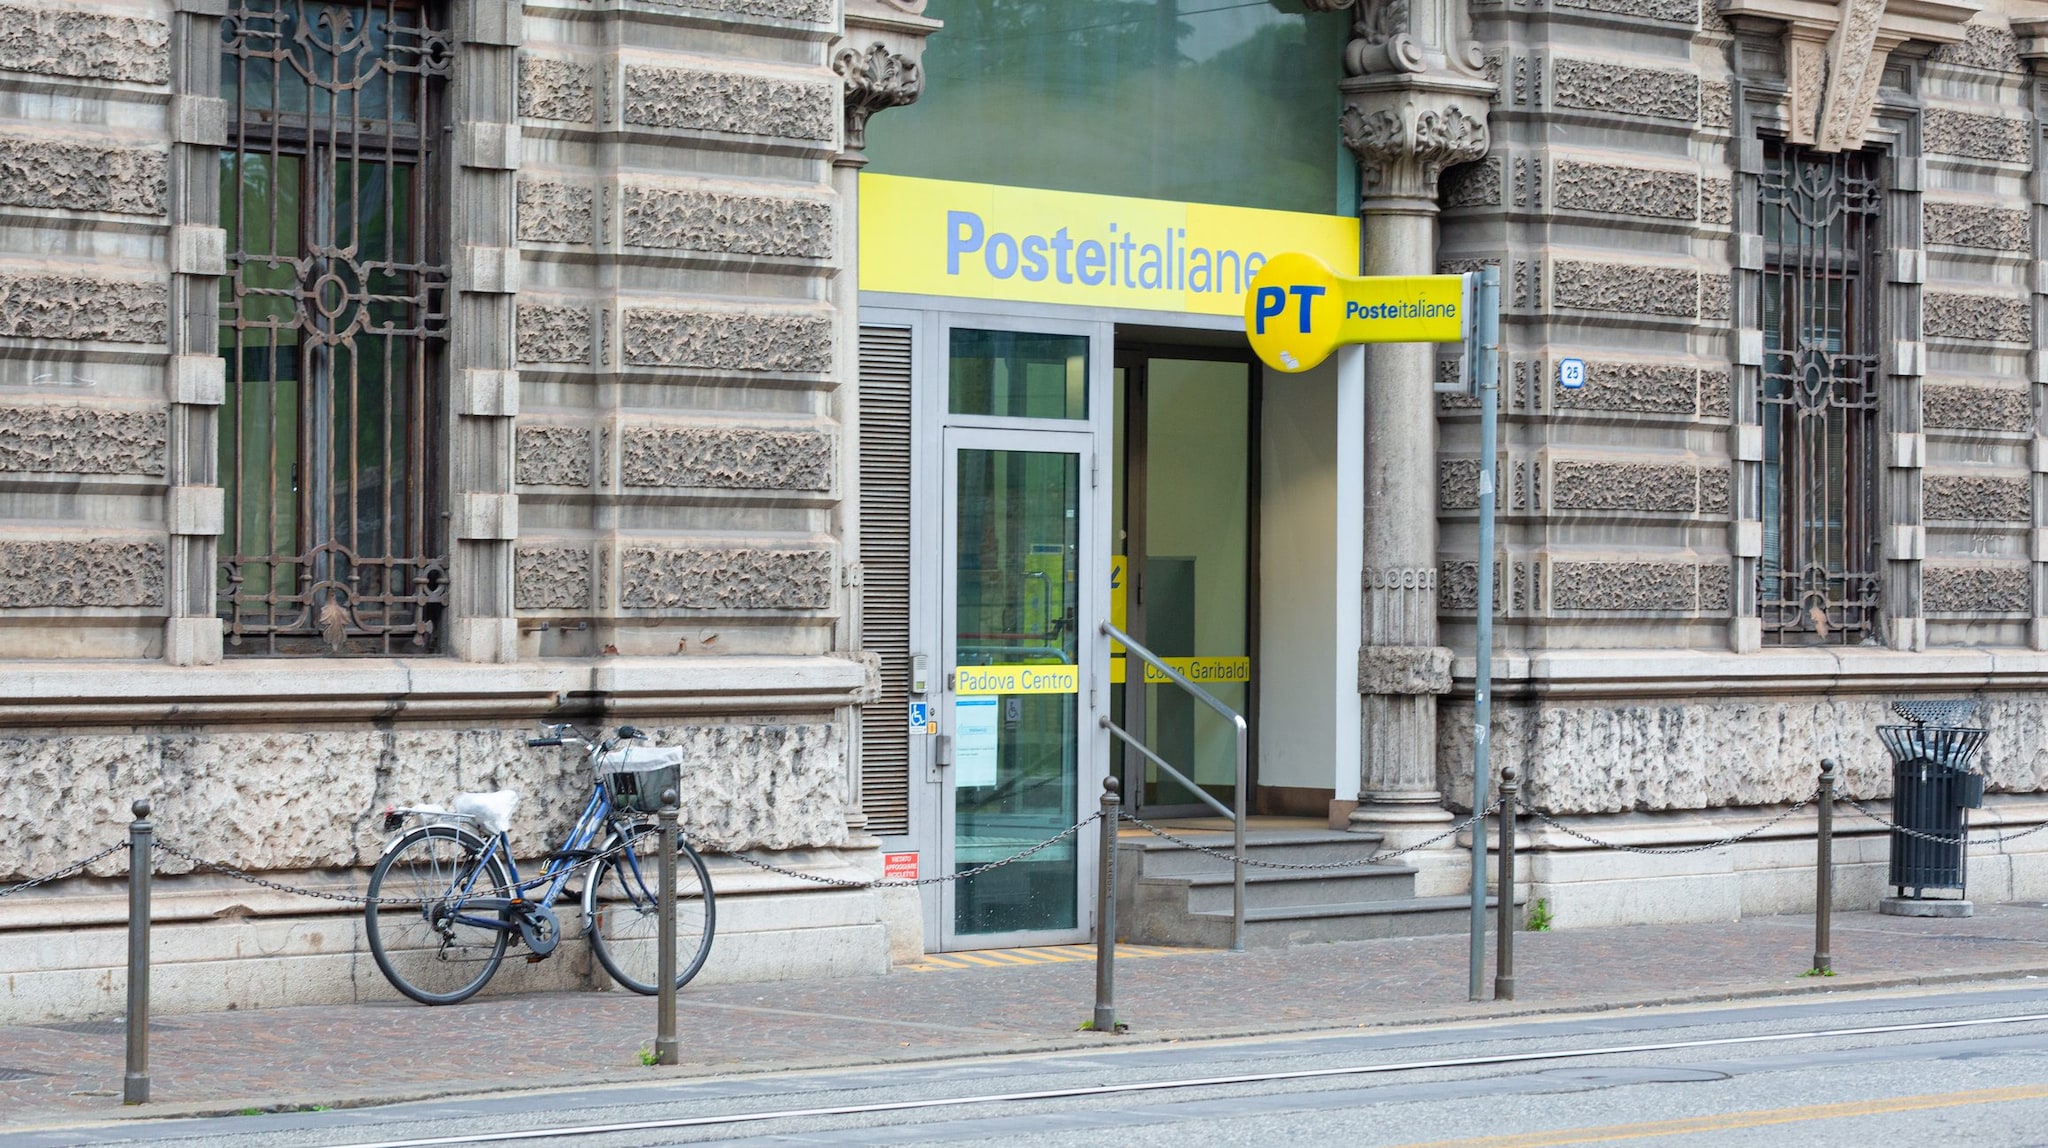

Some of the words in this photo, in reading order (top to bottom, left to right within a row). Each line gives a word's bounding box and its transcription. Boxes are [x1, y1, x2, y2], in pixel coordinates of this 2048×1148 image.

[946, 209, 1267, 295] Posteitaliane
[1256, 285, 1326, 335] PT
[1346, 299, 1456, 320] Posteitaliane
[1566, 366, 1579, 379] 25
[959, 671, 1015, 691] Padova
[1021, 670, 1073, 690] Centro
[1190, 661, 1249, 680] Garibaldi
